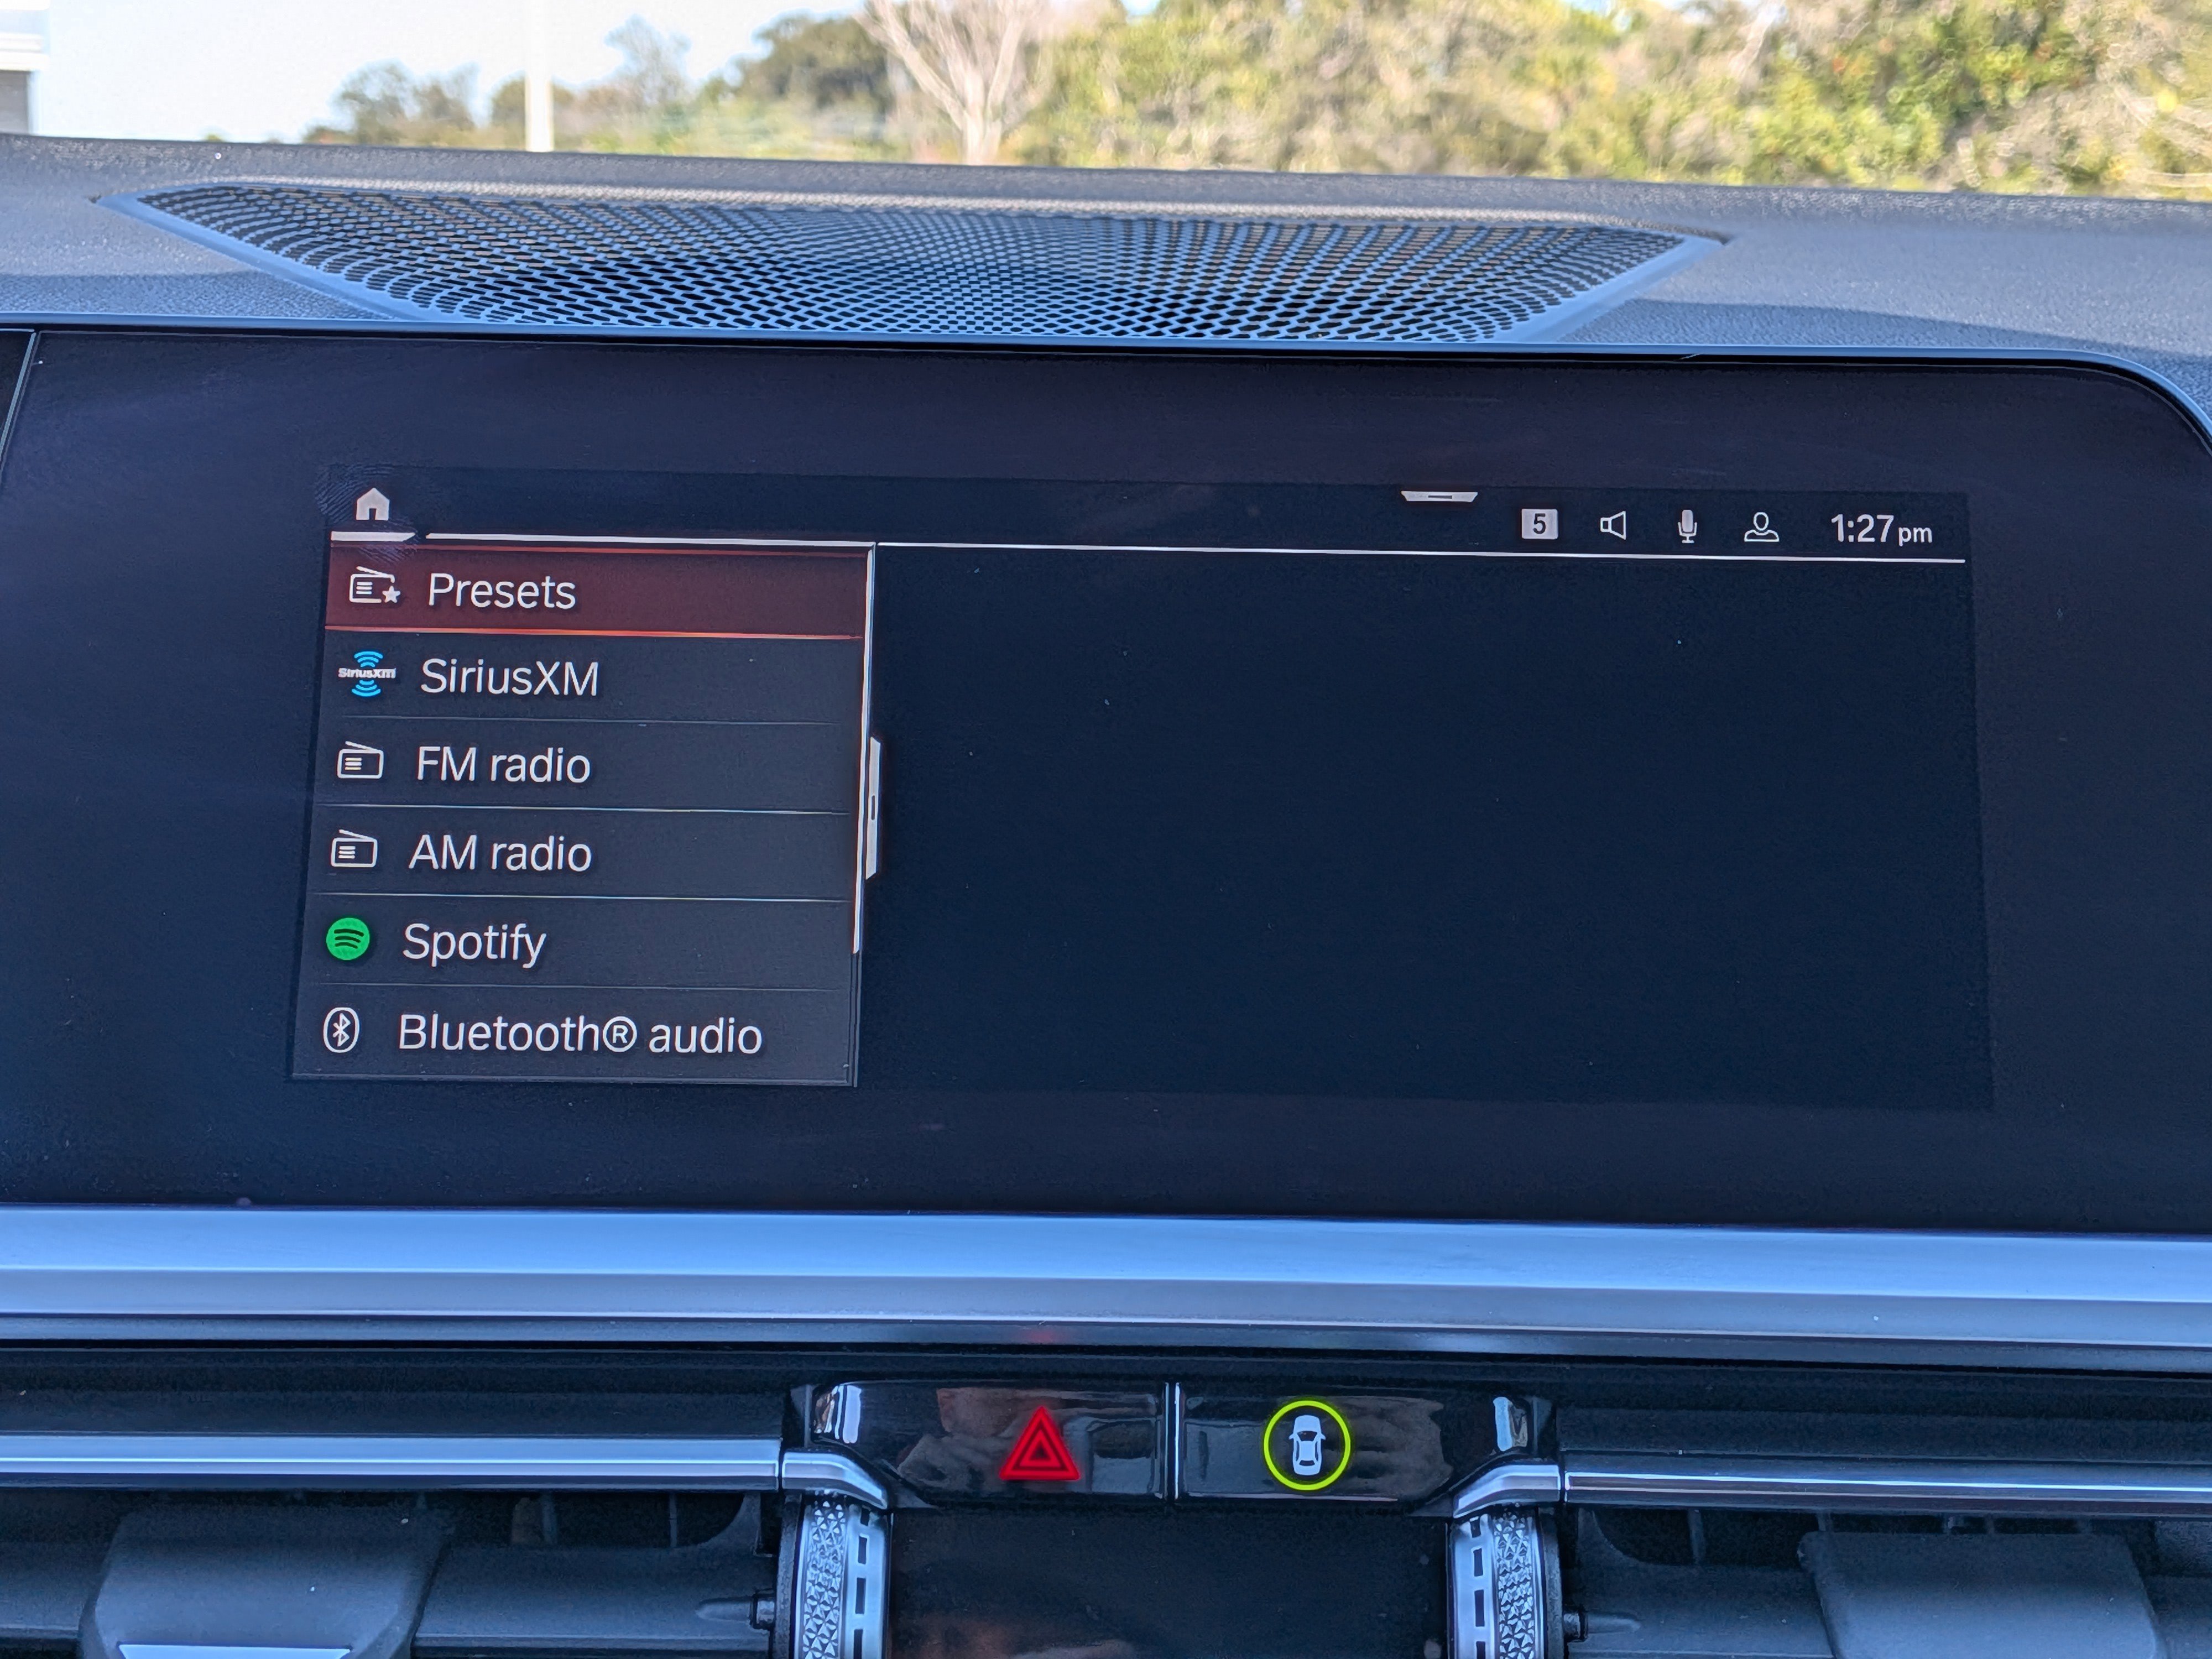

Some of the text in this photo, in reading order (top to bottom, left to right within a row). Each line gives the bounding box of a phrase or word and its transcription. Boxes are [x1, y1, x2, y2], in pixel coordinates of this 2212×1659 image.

[1533, 513, 1546, 534] 5
[428, 572, 576, 610] Presets
[420, 658, 599, 697] SiriusXM
[417, 745, 591, 784] FM radio
[408, 833, 592, 873] AM radio
[402, 922, 547, 969] Spotify
[399, 1014, 763, 1055] Bluetooth® audio
